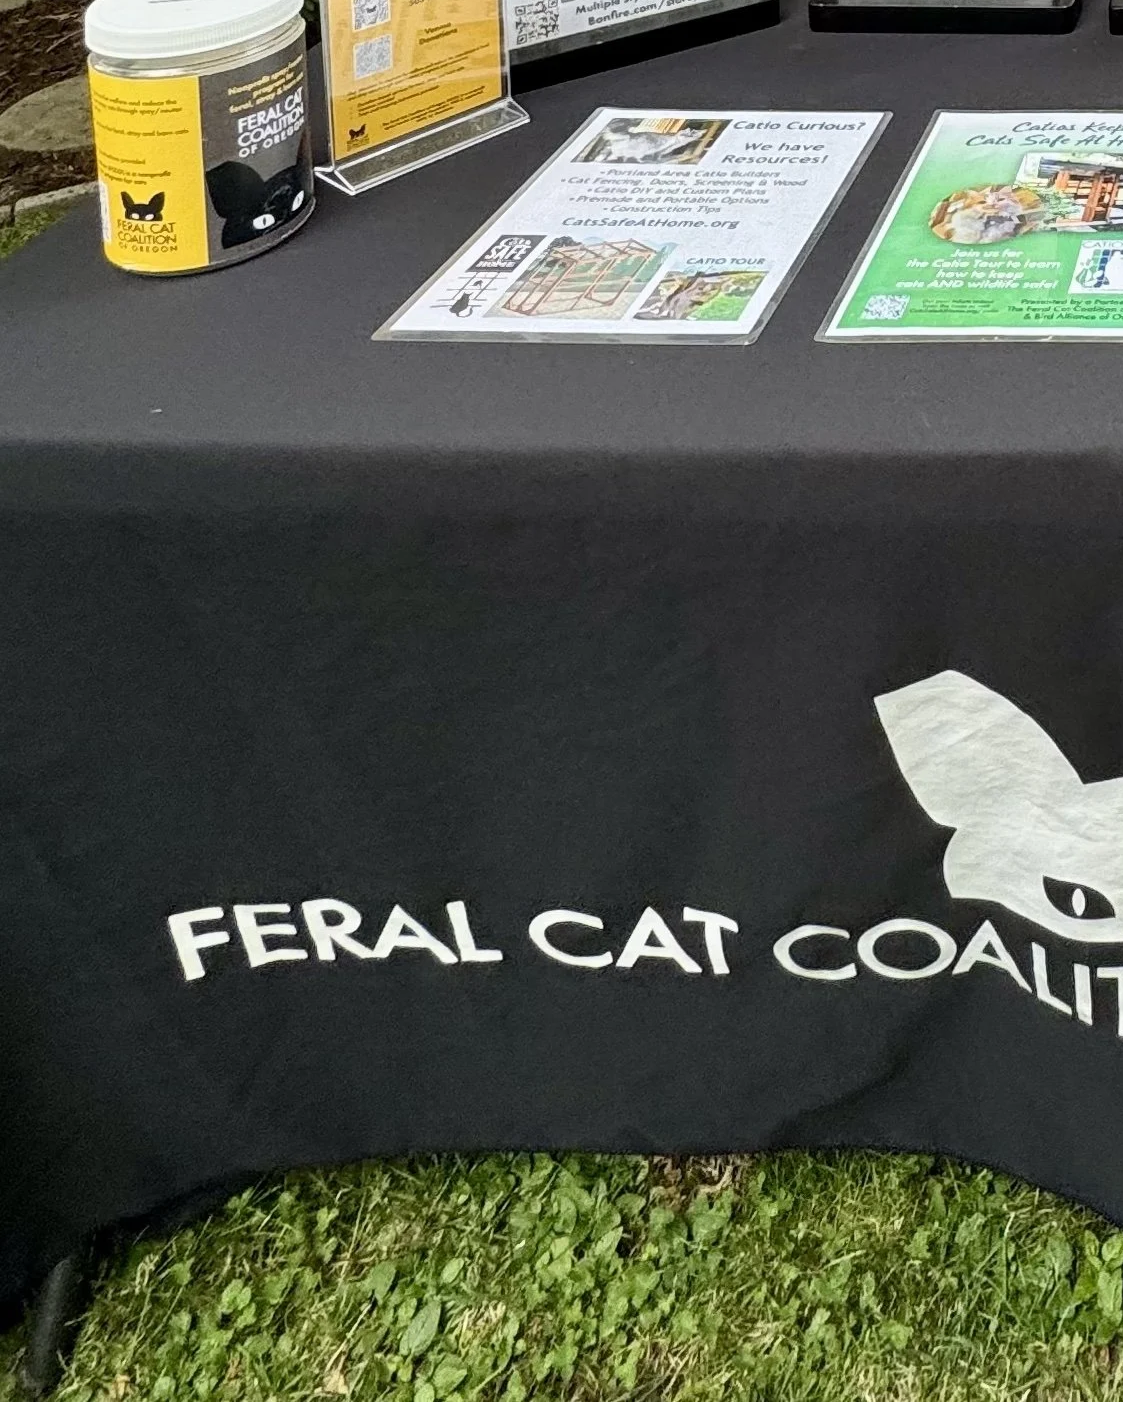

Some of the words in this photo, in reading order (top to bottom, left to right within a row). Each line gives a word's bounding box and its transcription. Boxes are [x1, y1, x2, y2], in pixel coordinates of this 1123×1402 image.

[238, 103, 283, 133] FERAL
[237, 102, 304, 147] COALITION
[732, 119, 781, 132] Catio
[785, 119, 867, 132] Curious?
[1012, 121, 1075, 133] Catios
[744, 141, 775, 152] We
[779, 141, 825, 152] have
[966, 134, 1012, 147] Cats
[1019, 134, 1070, 147] Safe
[1075, 134, 1101, 146] At
[239, 143, 258, 158] OF
[721, 154, 829, 165] Resources!
[592, 186, 629, 194] Catio
[630, 186, 653, 194] DIY
[655, 186, 680, 195] and
[683, 187, 730, 195] Custom
[732, 187, 767, 196] Plans
[575, 195, 633, 204] Premade
[635, 195, 660, 204] and
[663, 196, 718, 204] Portable
[720, 196, 769, 206] Options
[610, 204, 692, 213] Construction
[697, 205, 721, 214] Tips
[117, 218, 147, 234] FERAL
[150, 222, 176, 234] CAT
[562, 217, 740, 230] CatsSafeAtHome.org
[117, 230, 177, 245] COALITION
[131, 245, 178, 253] OREGON
[484, 245, 532, 260] SAFE
[951, 248, 981, 258] Join
[983, 250, 1000, 258] us
[1002, 248, 1024, 258] for
[686, 257, 727, 265] CATIO
[730, 257, 767, 265] TOUR
[906, 258, 929, 268] the
[931, 258, 970, 268] Catio
[973, 258, 1005, 269] Tour
[1006, 259, 1021, 269] to
[1024, 260, 1061, 270] learn
[936, 269, 969, 278] how
[970, 269, 986, 279] to
[988, 269, 1024, 280] keep
[895, 280, 924, 288] cats
[927, 280, 964, 288] AND
[967, 279, 1019, 289] wildlife
[1022, 279, 1059, 290] safe!
[167, 898, 503, 983] FERAL
[528, 906, 739, 977] CAT
